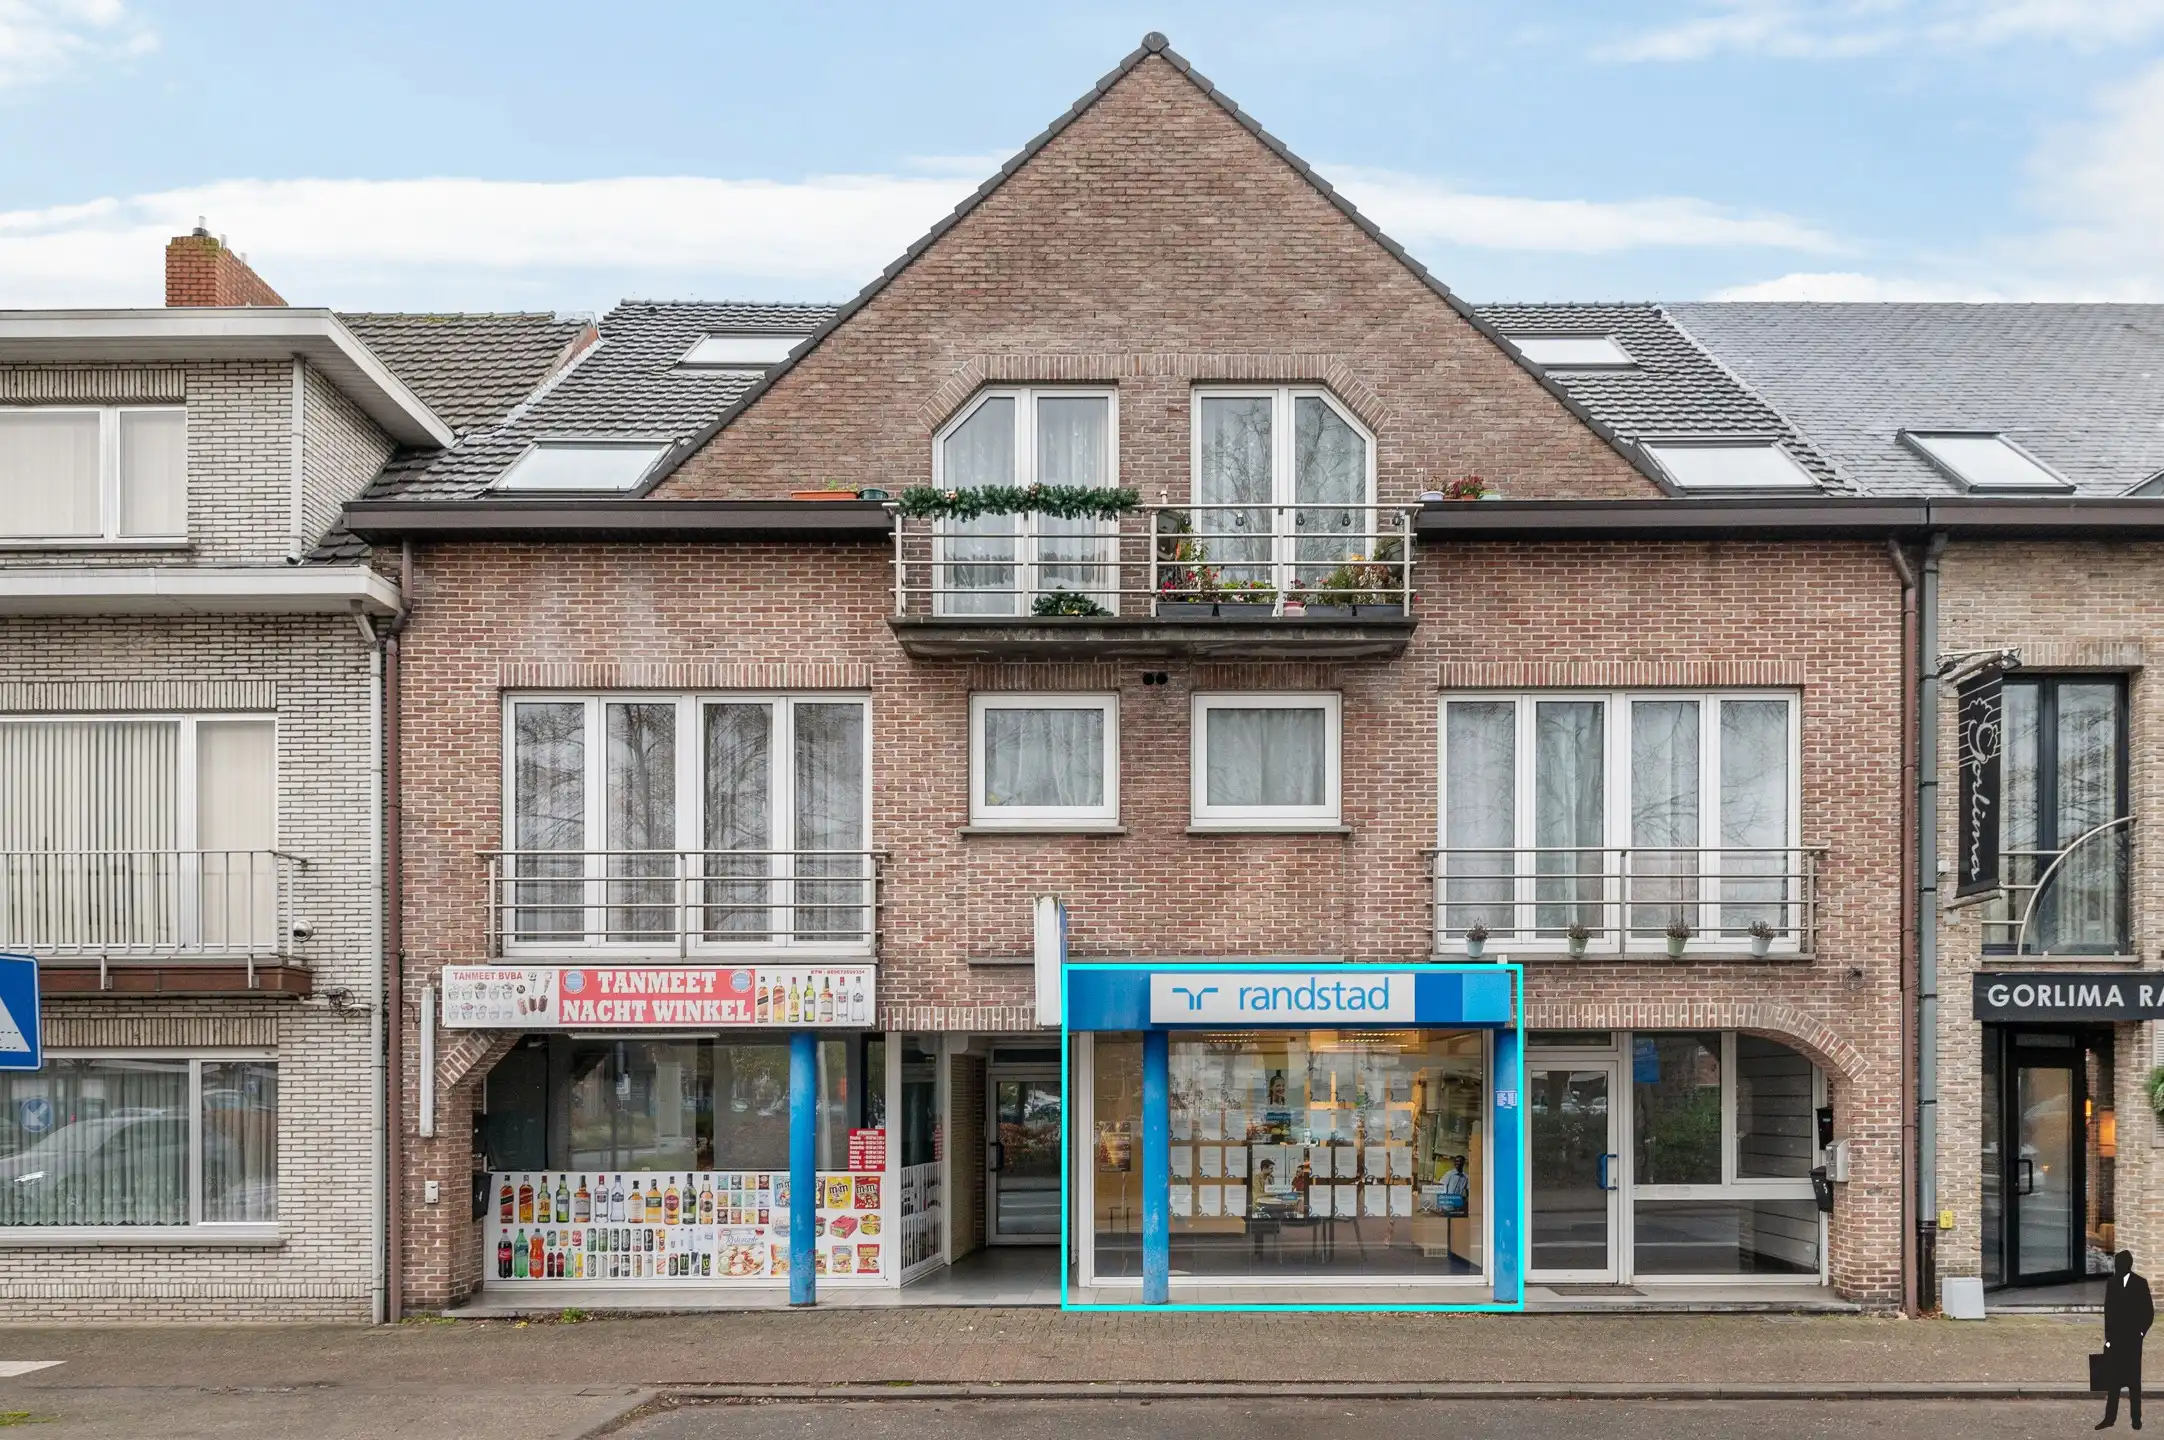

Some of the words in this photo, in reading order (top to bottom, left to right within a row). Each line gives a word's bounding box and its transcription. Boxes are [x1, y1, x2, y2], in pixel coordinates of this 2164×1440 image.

[453, 971, 495, 981] TANMEET
[498, 971, 523, 981] BVBA
[597, 971, 717, 994] TANMEET
[1239, 977, 1389, 1011] randstad
[1987, 983, 2126, 1008] GORLIMA
[562, 999, 647, 1022] NACHT
[651, 999, 751, 1022] WINKEL
